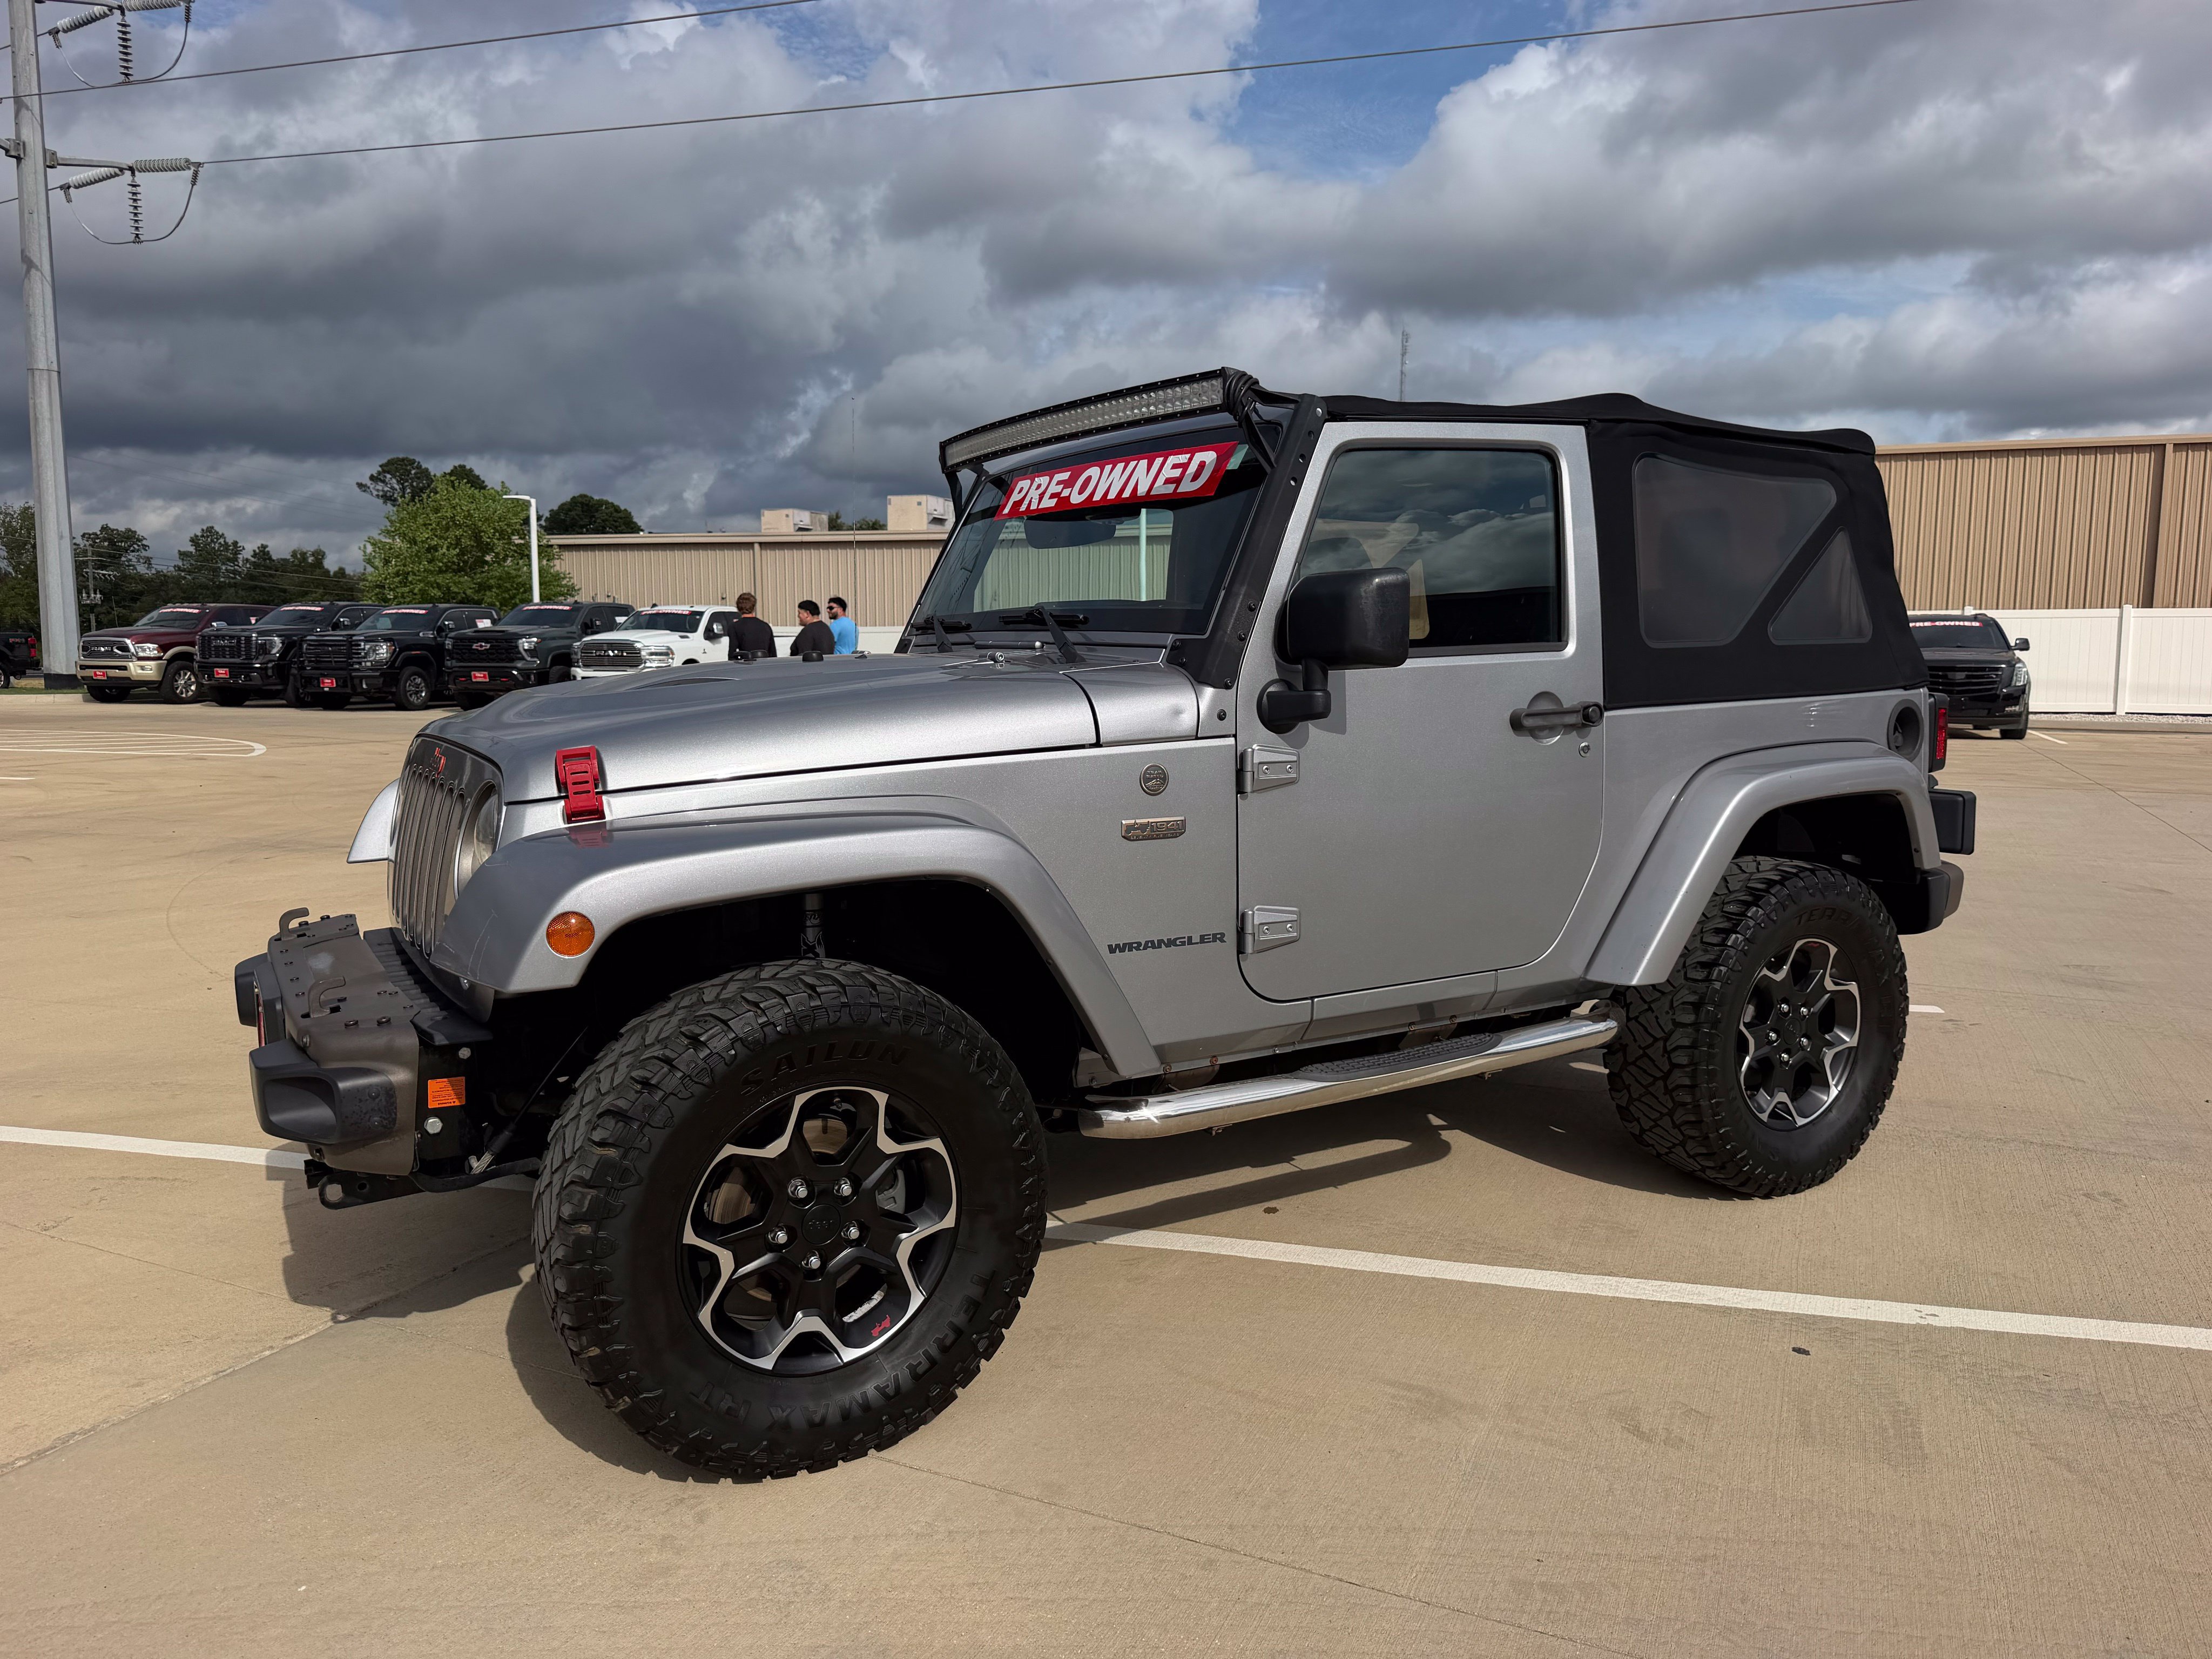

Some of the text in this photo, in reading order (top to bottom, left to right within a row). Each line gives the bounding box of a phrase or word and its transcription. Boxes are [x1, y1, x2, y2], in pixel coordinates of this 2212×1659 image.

[1002, 450, 1217, 515] PRE-OWNED
[1151, 820, 1183, 832] 1941
[1107, 932, 1227, 954] WRANGLER
[740, 1038, 913, 1097] SAILUN
[688, 1269, 997, 1431] TERRAMAX RT
